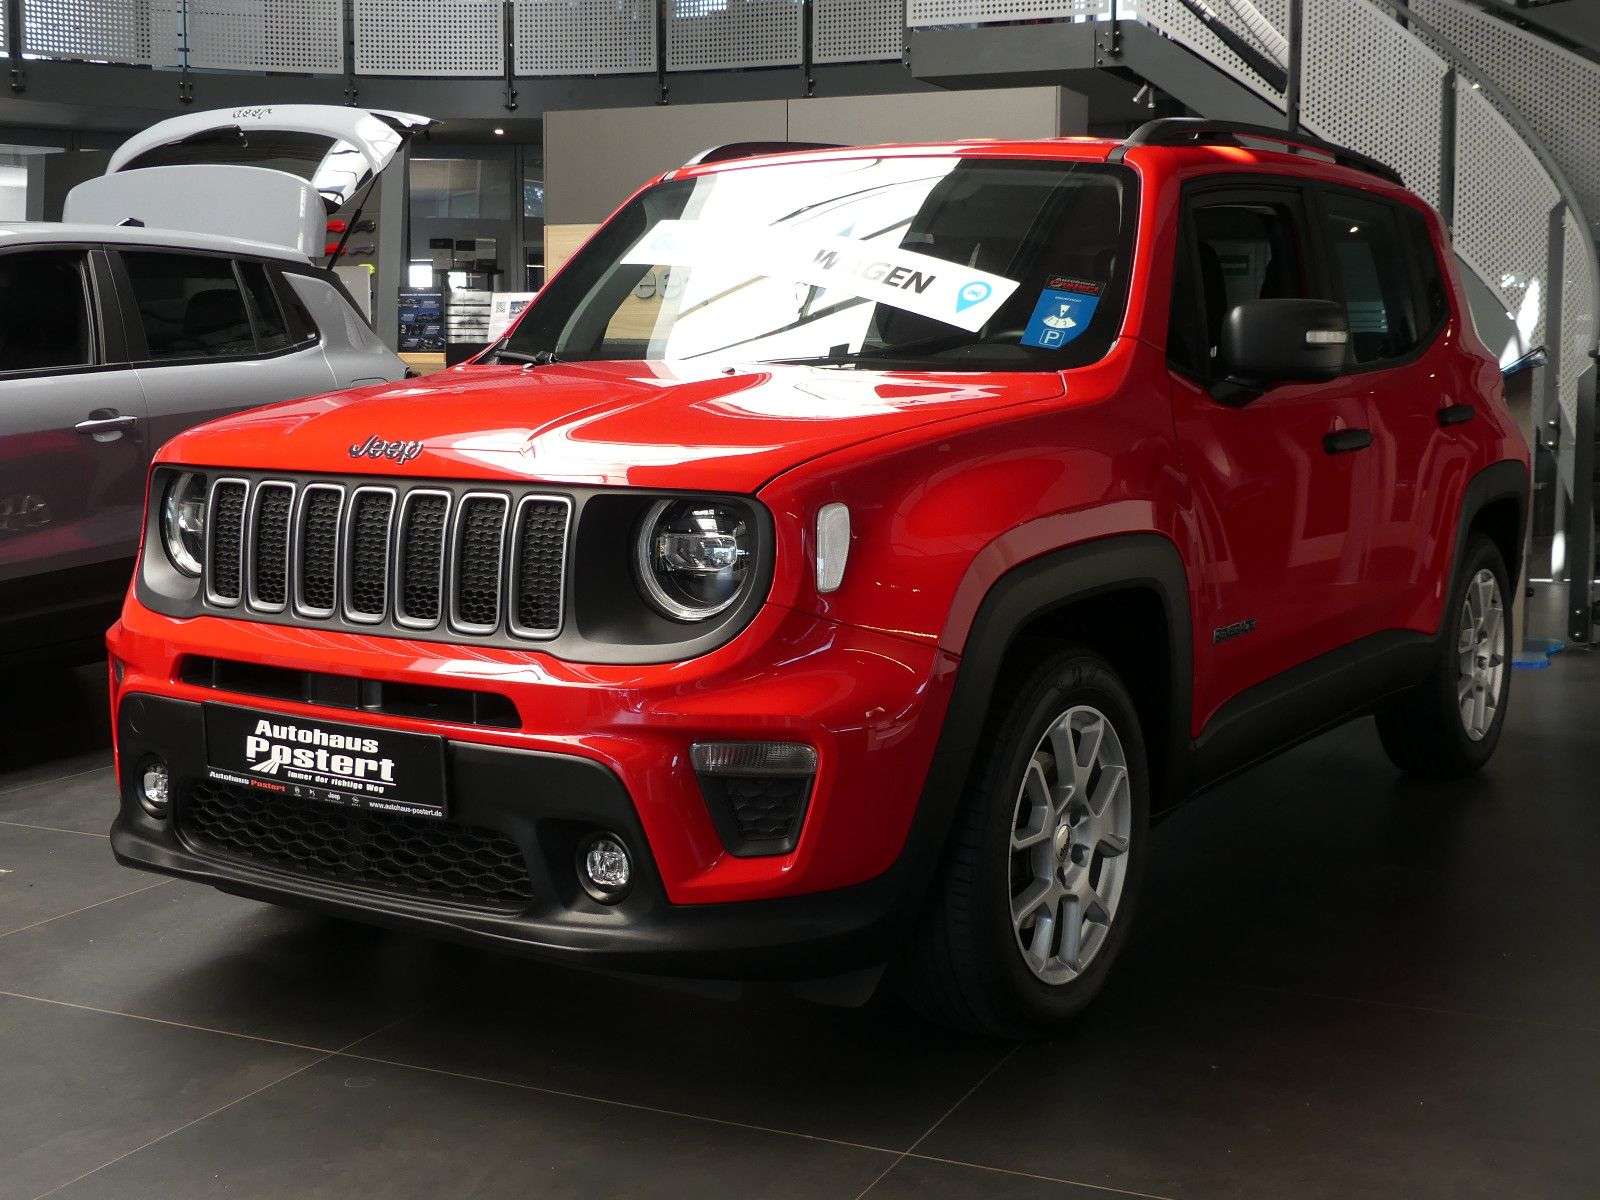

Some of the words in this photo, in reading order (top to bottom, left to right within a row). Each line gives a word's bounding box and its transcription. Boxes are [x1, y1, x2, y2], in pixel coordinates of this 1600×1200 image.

[812, 247, 936, 295] WGEN
[349, 434, 424, 464] Jeep
[254, 719, 379, 754] Autohaus
[246, 735, 394, 782] Postert
[209, 770, 250, 785] Autohaus
[250, 778, 287, 793] Postert
[315, 774, 329, 784] der
[331, 776, 364, 790] richtige
[366, 782, 385, 794] Weg
[369, 800, 443, 817] www.autohaus-postert.de
